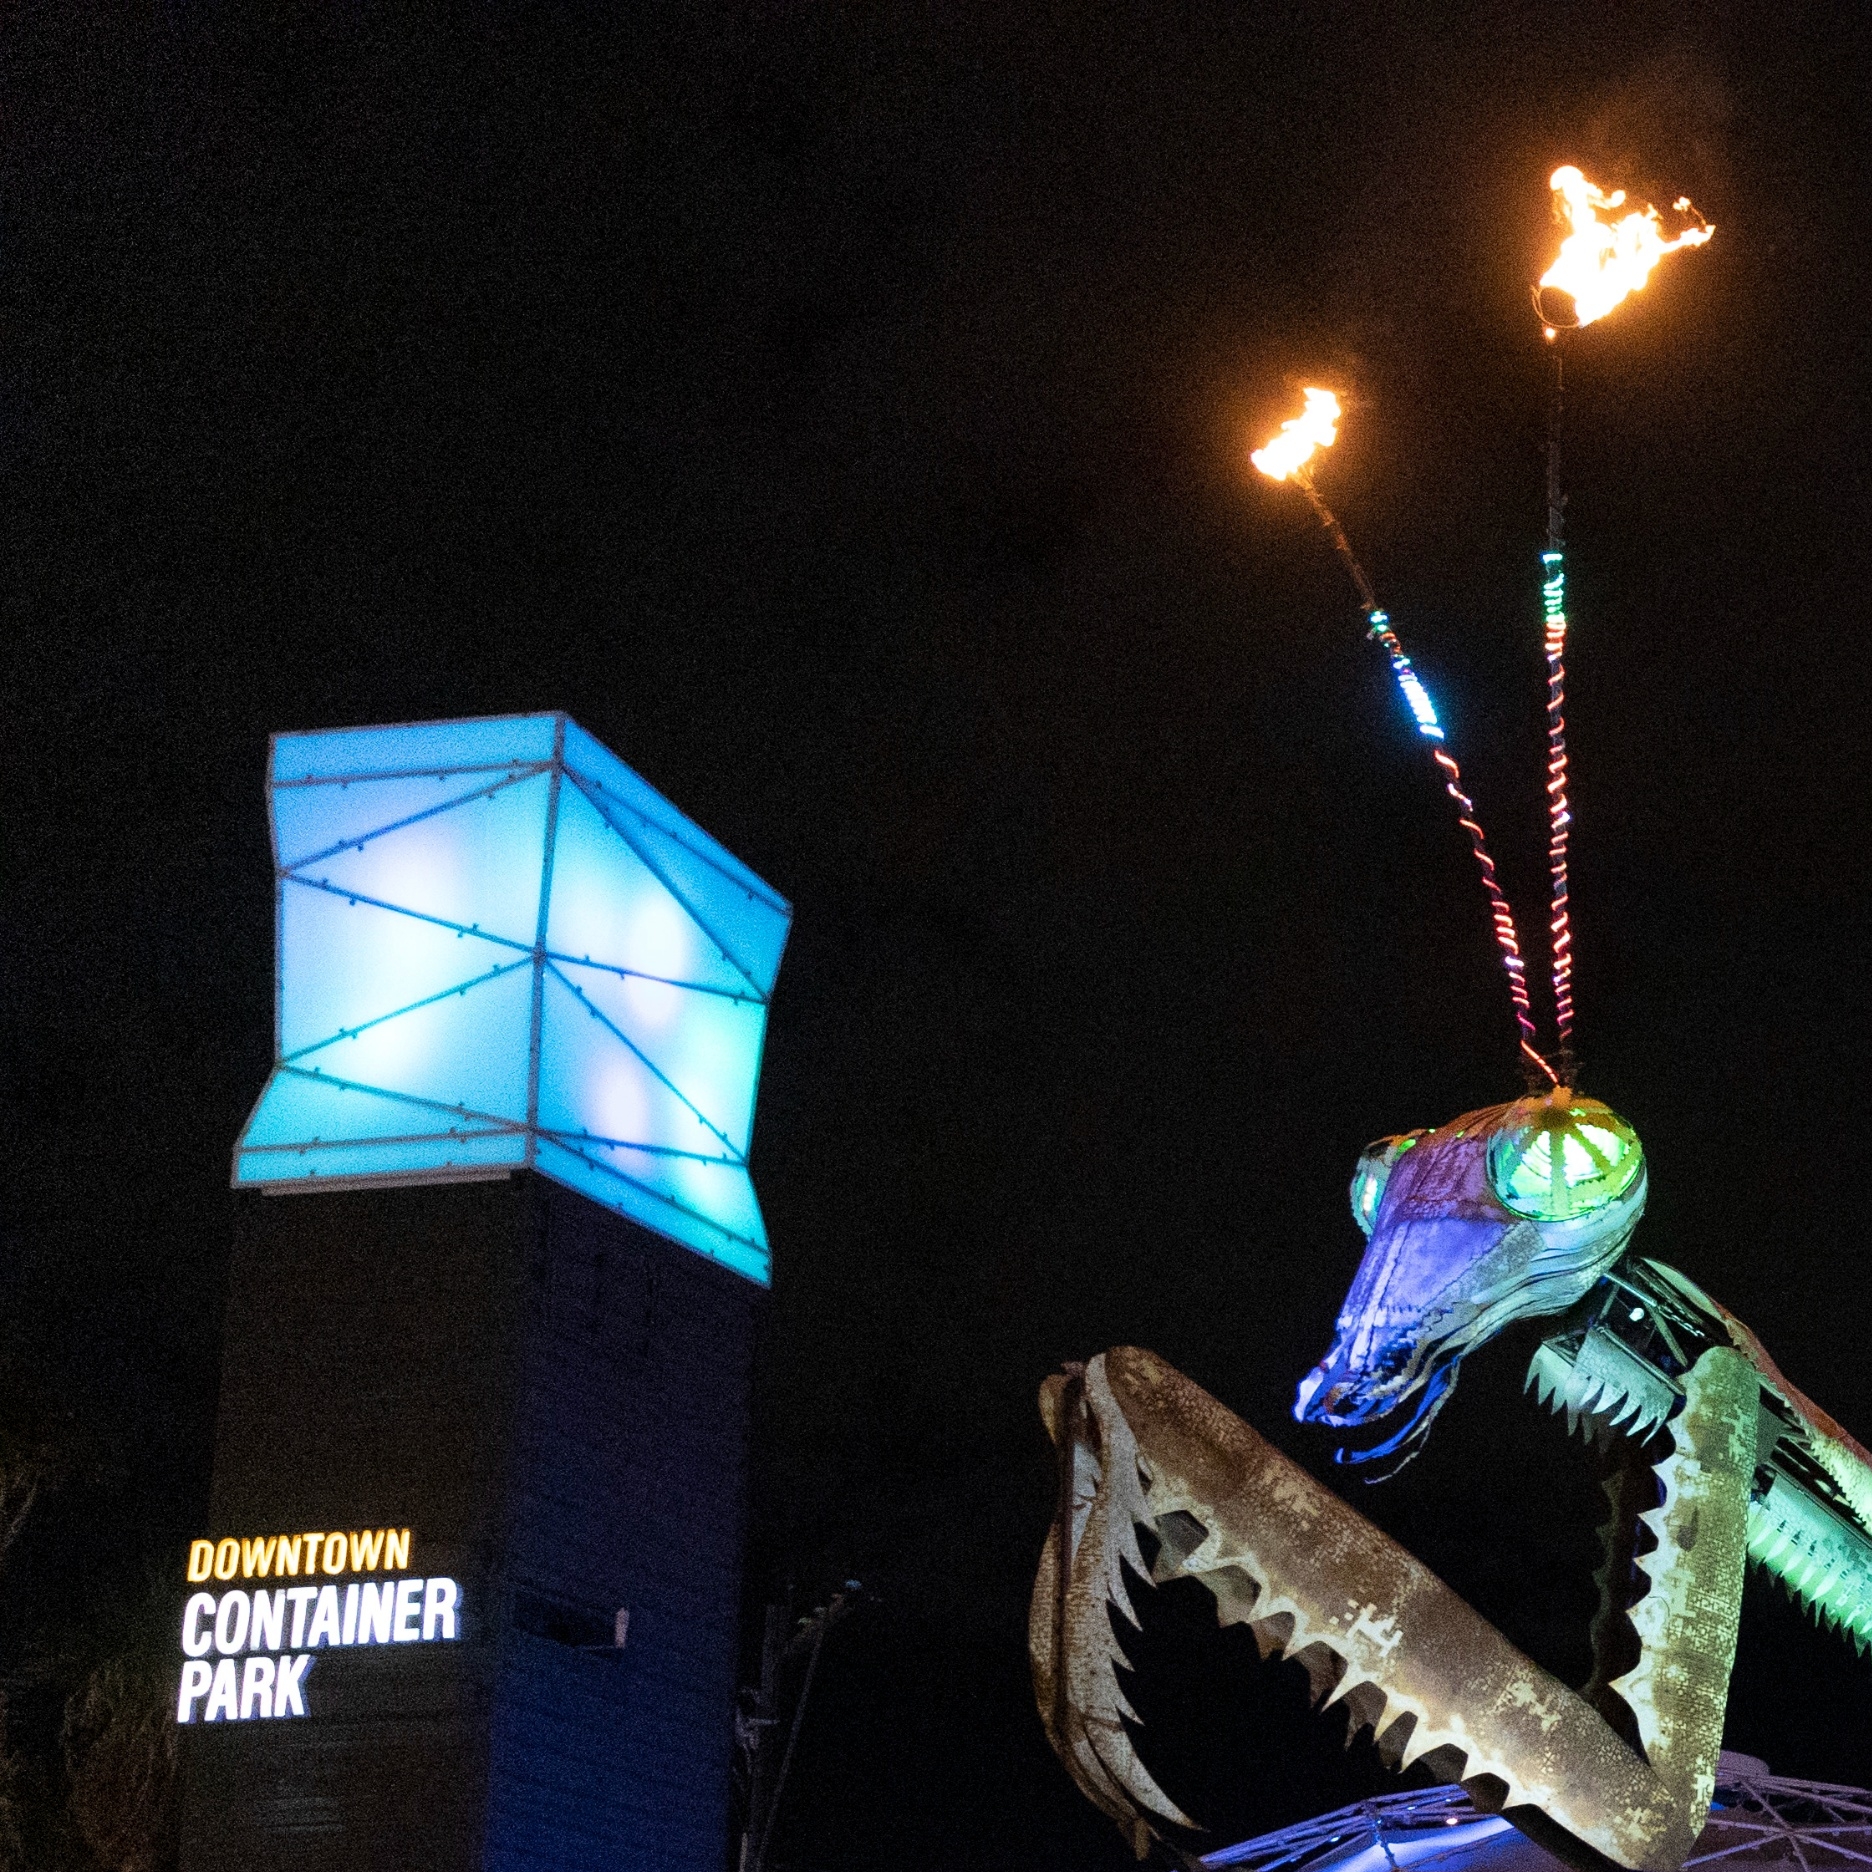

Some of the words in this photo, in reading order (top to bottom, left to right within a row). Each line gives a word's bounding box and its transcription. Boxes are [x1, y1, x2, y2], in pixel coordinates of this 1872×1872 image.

[187, 1528, 411, 1582] DOWNTOWN
[182, 1577, 460, 1657] CONTAINER
[177, 1654, 312, 1723] PARK
